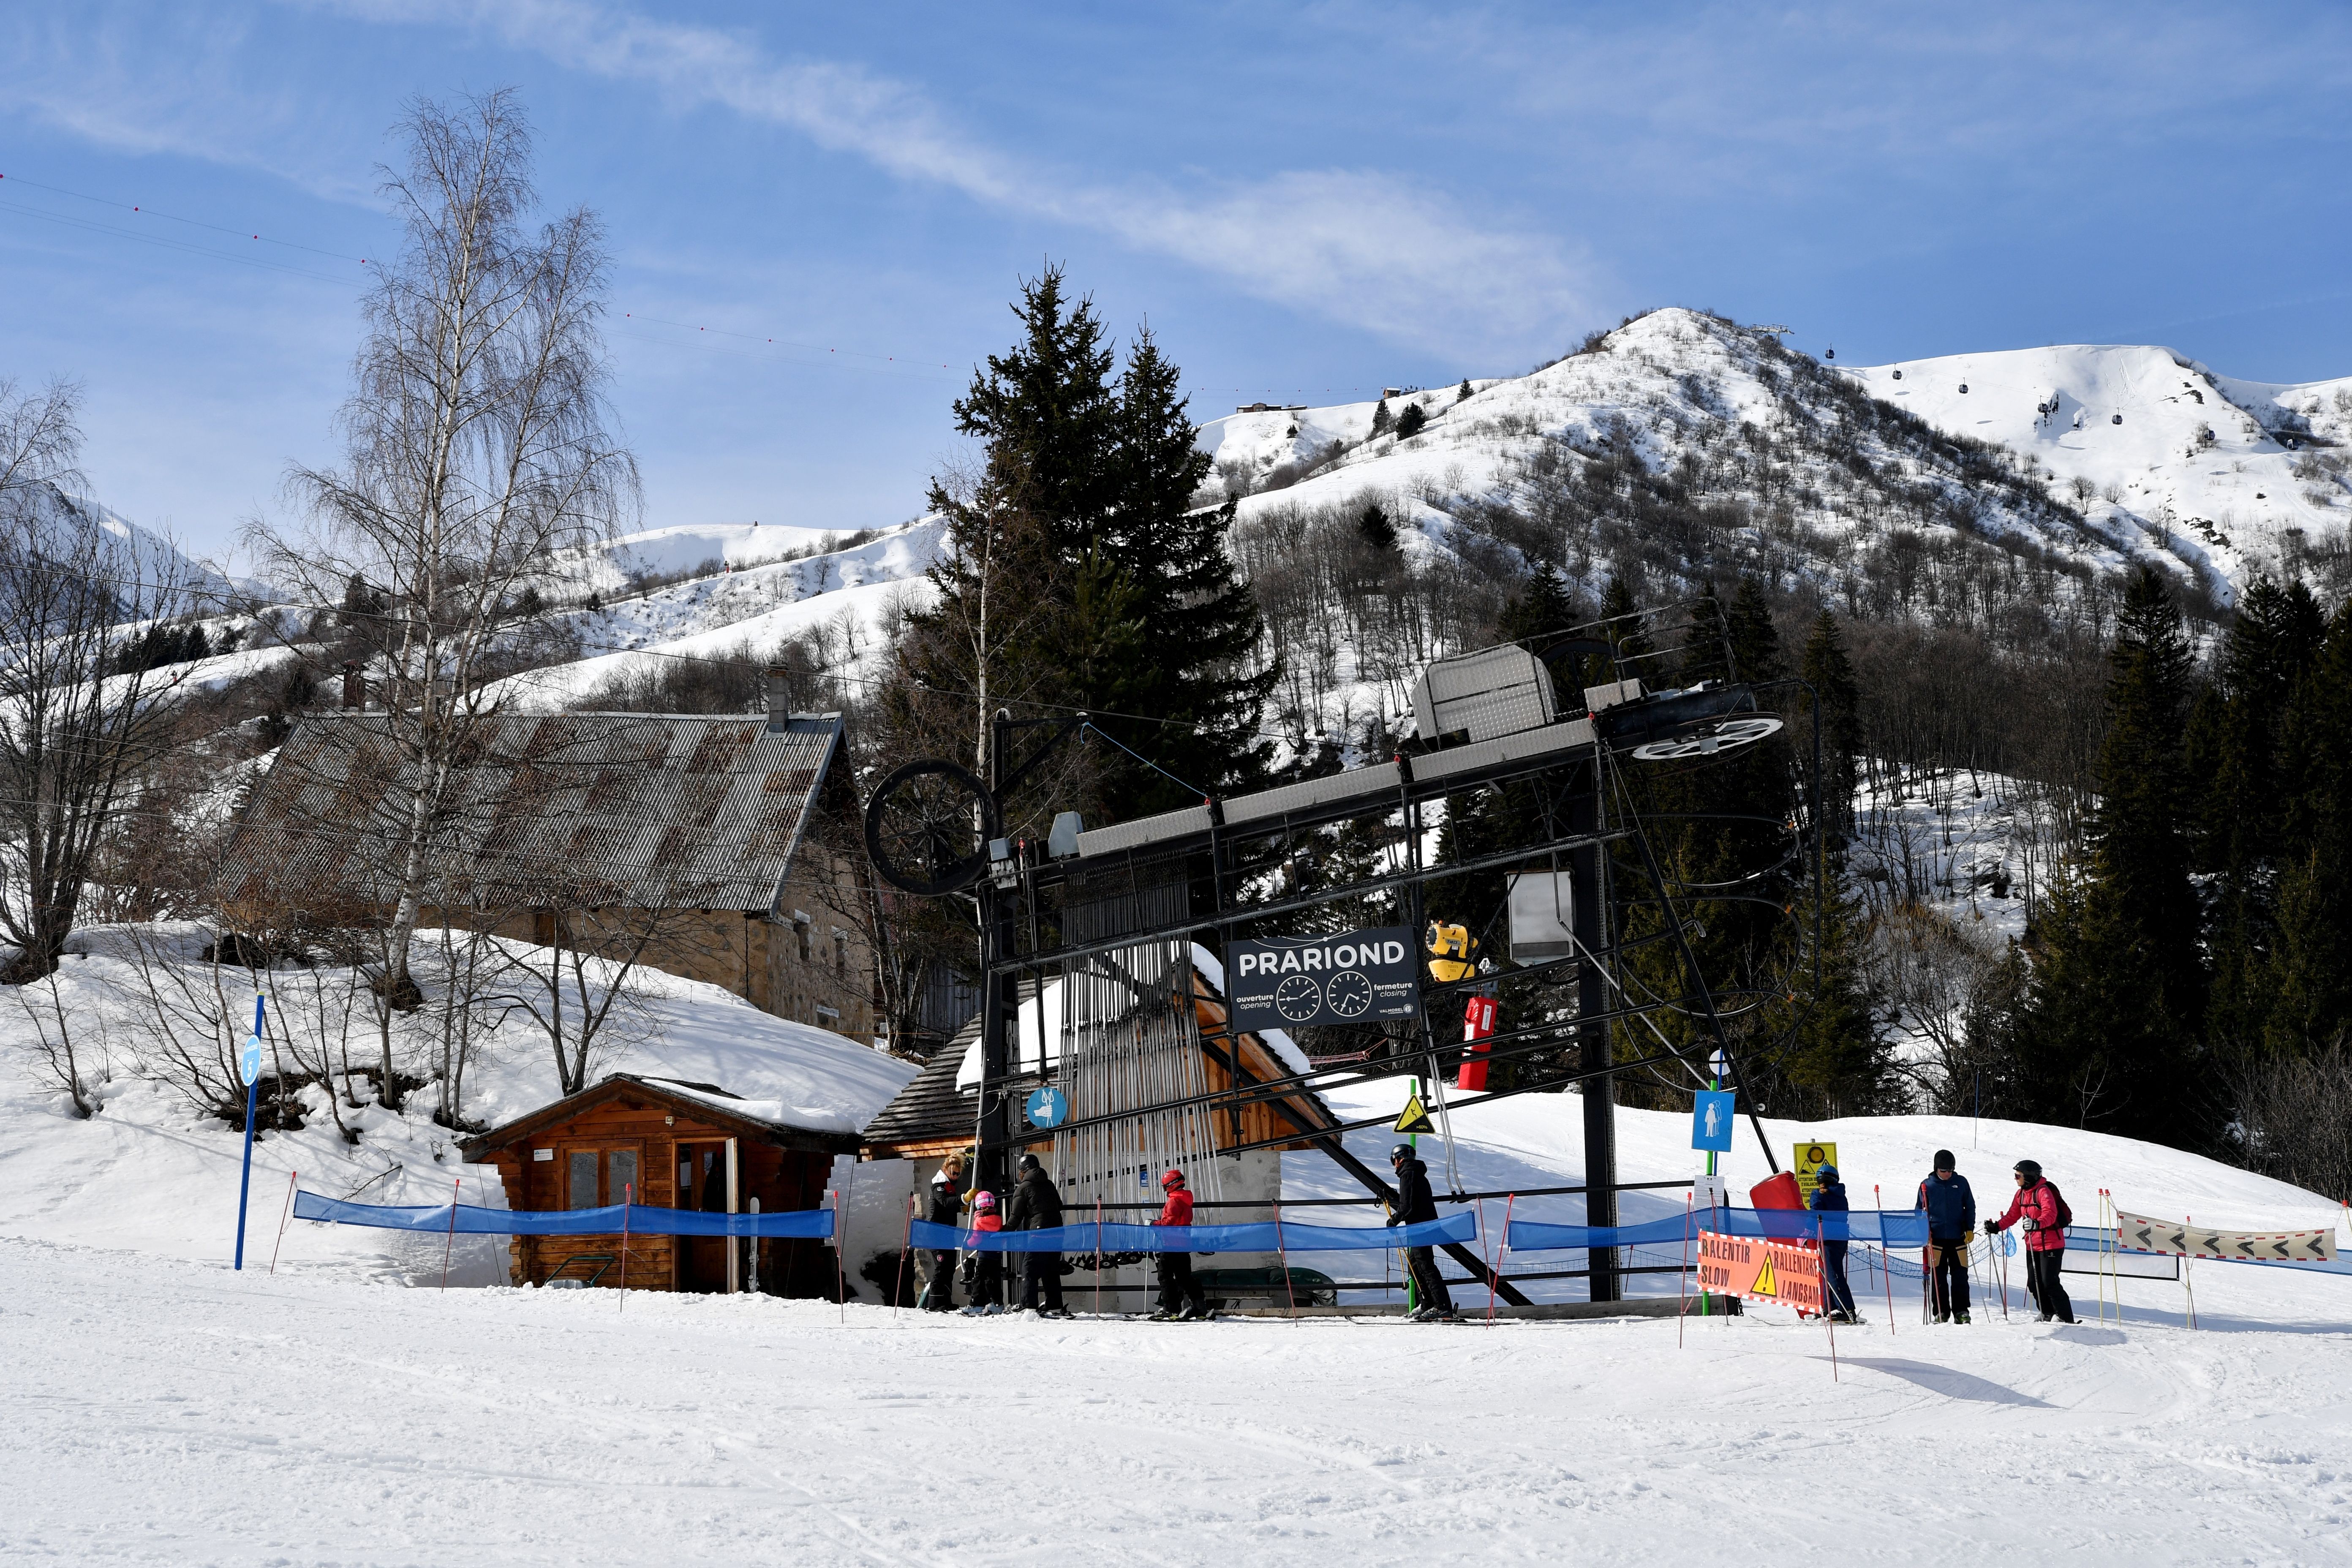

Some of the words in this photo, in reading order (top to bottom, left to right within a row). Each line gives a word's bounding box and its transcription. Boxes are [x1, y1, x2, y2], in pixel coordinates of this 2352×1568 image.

[1239, 941, 1404, 977] PRARIOND
[1374, 983, 1412, 991] fermeture
[1380, 989, 1407, 997] closing
[1236, 994, 1274, 1002] ouverture
[1240, 1001, 1271, 1010] opening
[247, 1061, 252, 1078] 5
[1702, 1238, 1750, 1264] RALENTIR
[1701, 1265, 1730, 1287] SLOW
[1781, 1280, 1818, 1306] LANGSAM
